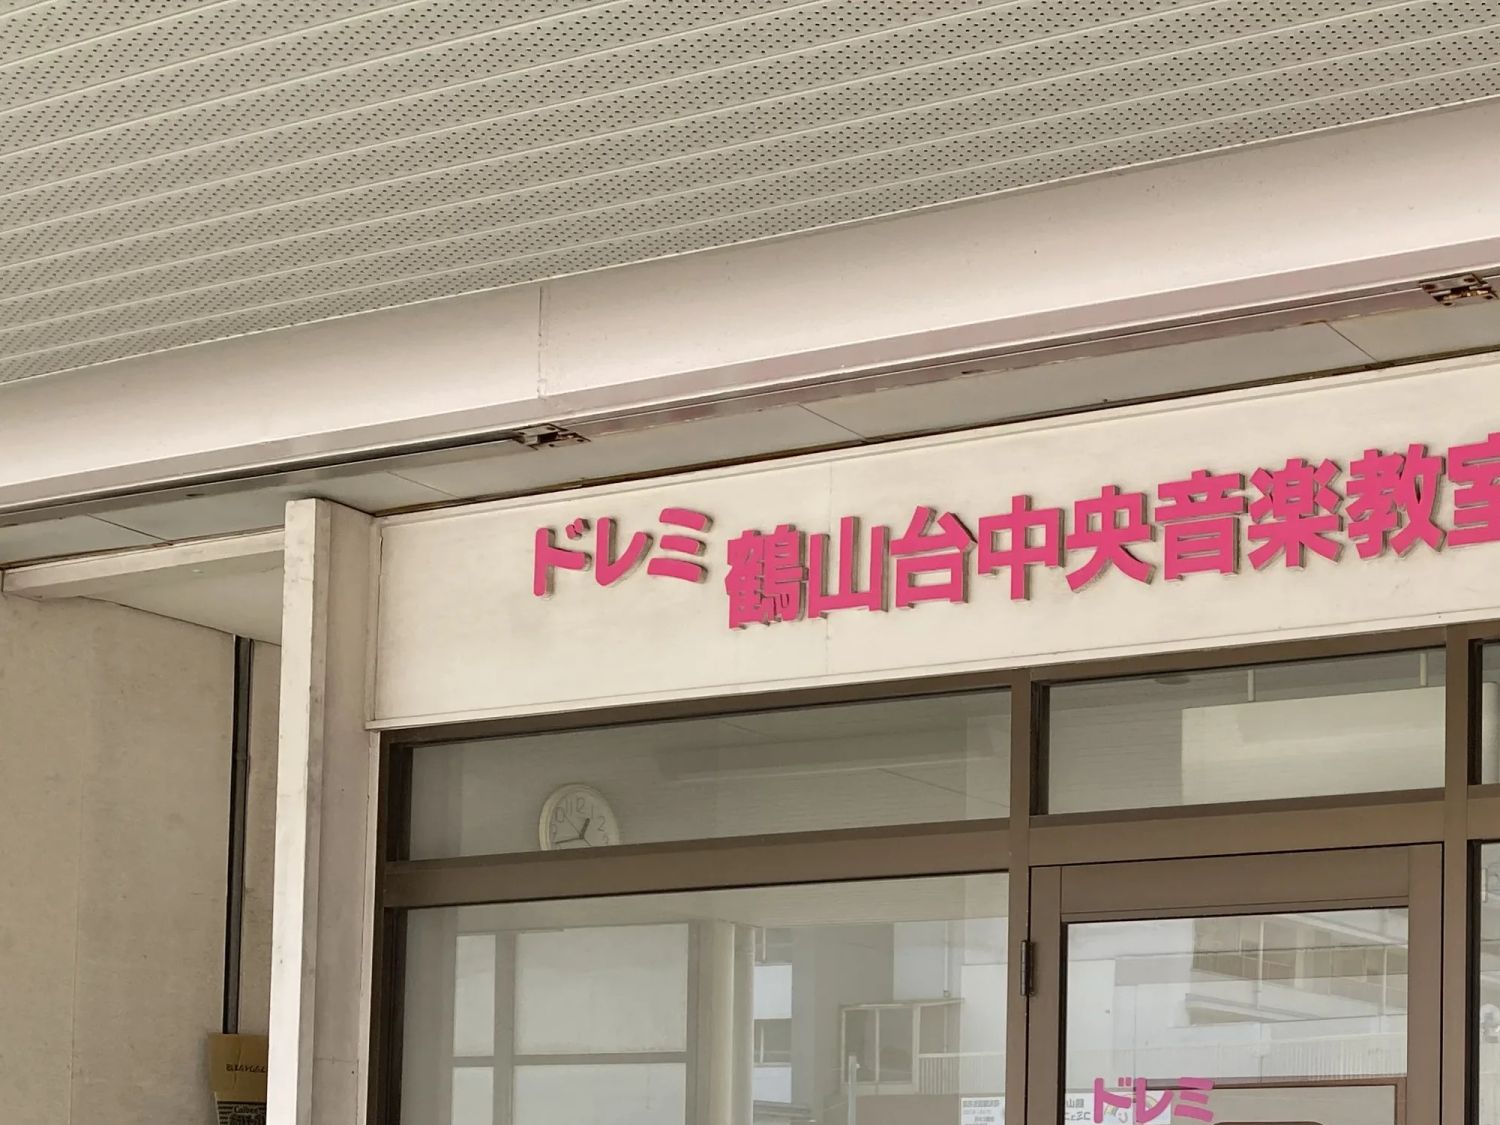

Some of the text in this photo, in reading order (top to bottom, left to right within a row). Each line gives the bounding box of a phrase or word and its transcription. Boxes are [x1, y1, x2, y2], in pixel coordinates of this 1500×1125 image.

[533, 507, 706, 597] ドレミ
[1093, 1077, 1216, 1124] ドレミ
